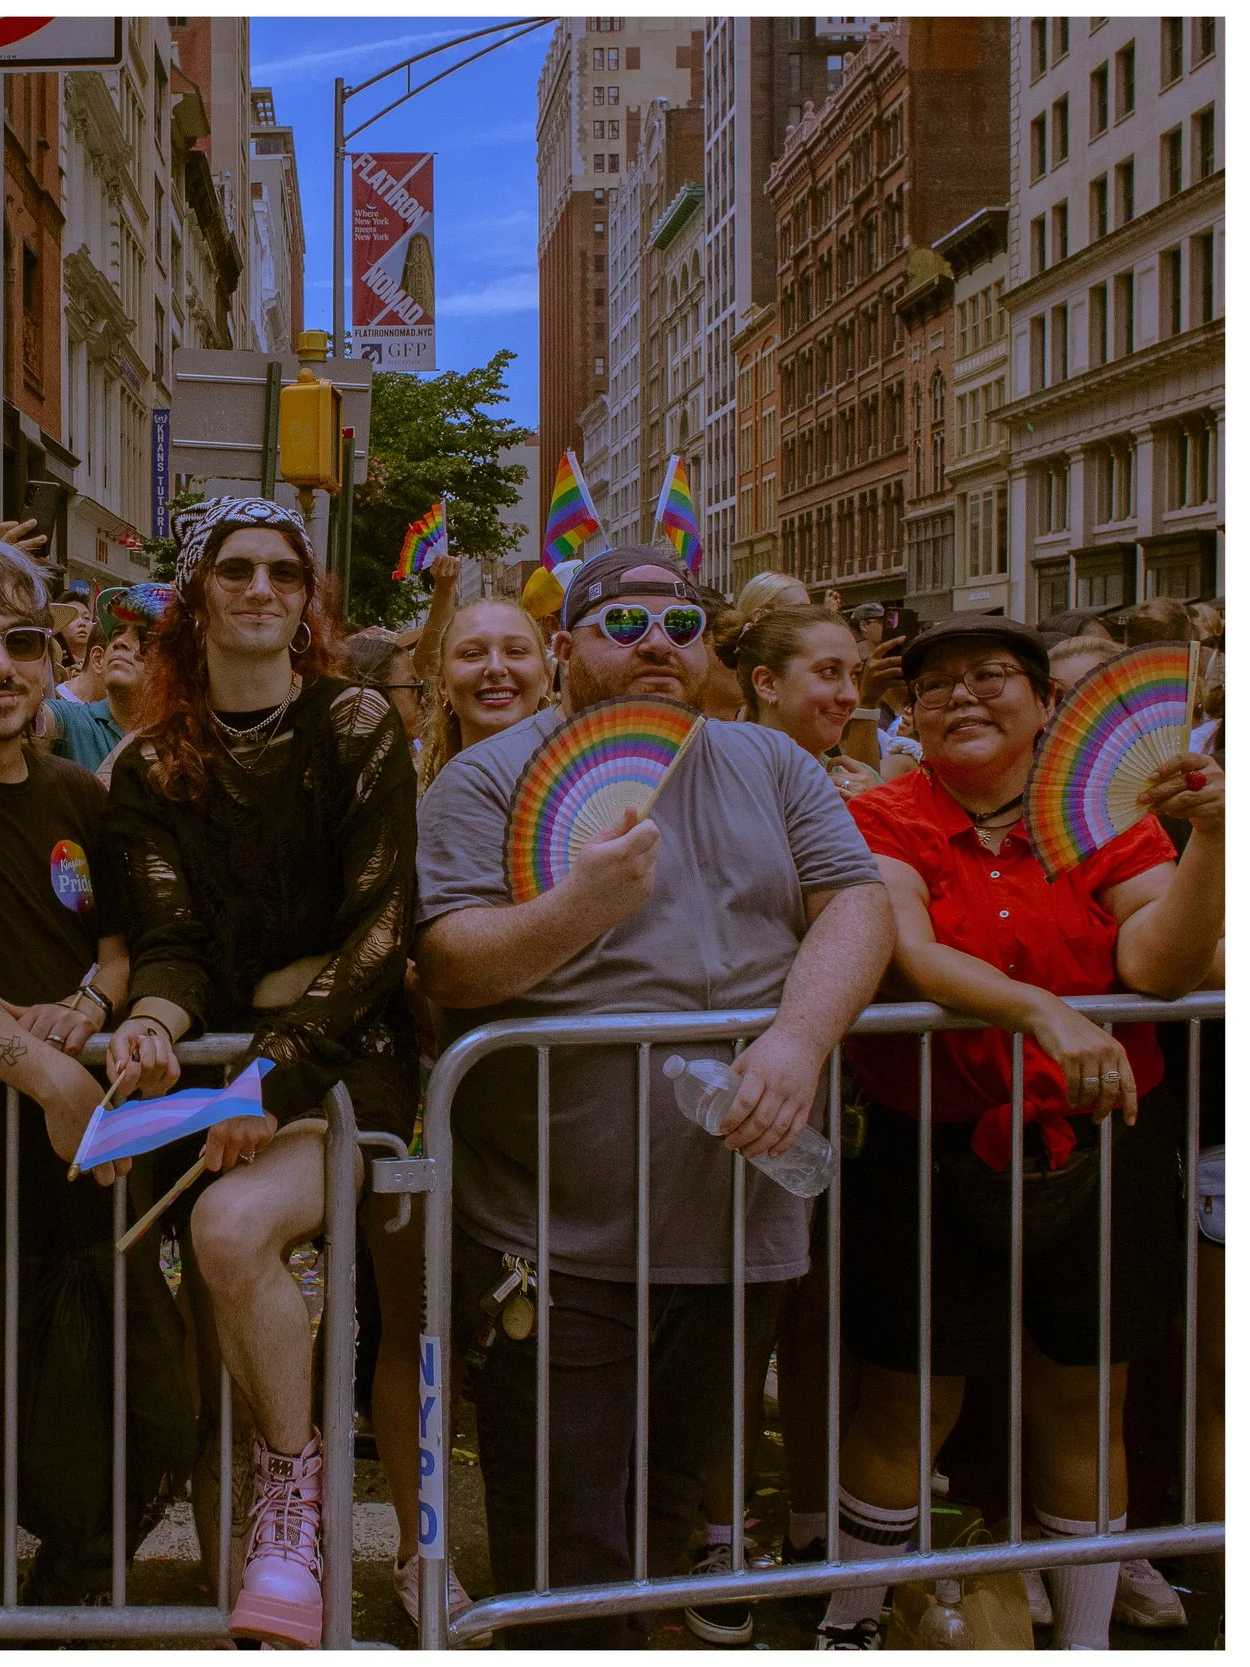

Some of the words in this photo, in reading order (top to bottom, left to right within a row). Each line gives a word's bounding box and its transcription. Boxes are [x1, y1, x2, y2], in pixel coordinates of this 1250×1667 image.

[352, 153, 431, 224] FLATIRON
[355, 209, 379, 217] Where
[372, 217, 389, 225] York
[373, 233, 390, 241] York
[361, 266, 424, 325] NOMAD
[355, 328, 433, 338] FLATIRONNOMAD.NYC
[388, 343, 427, 357] GFP
[418, 1343, 438, 1545] NYPD
